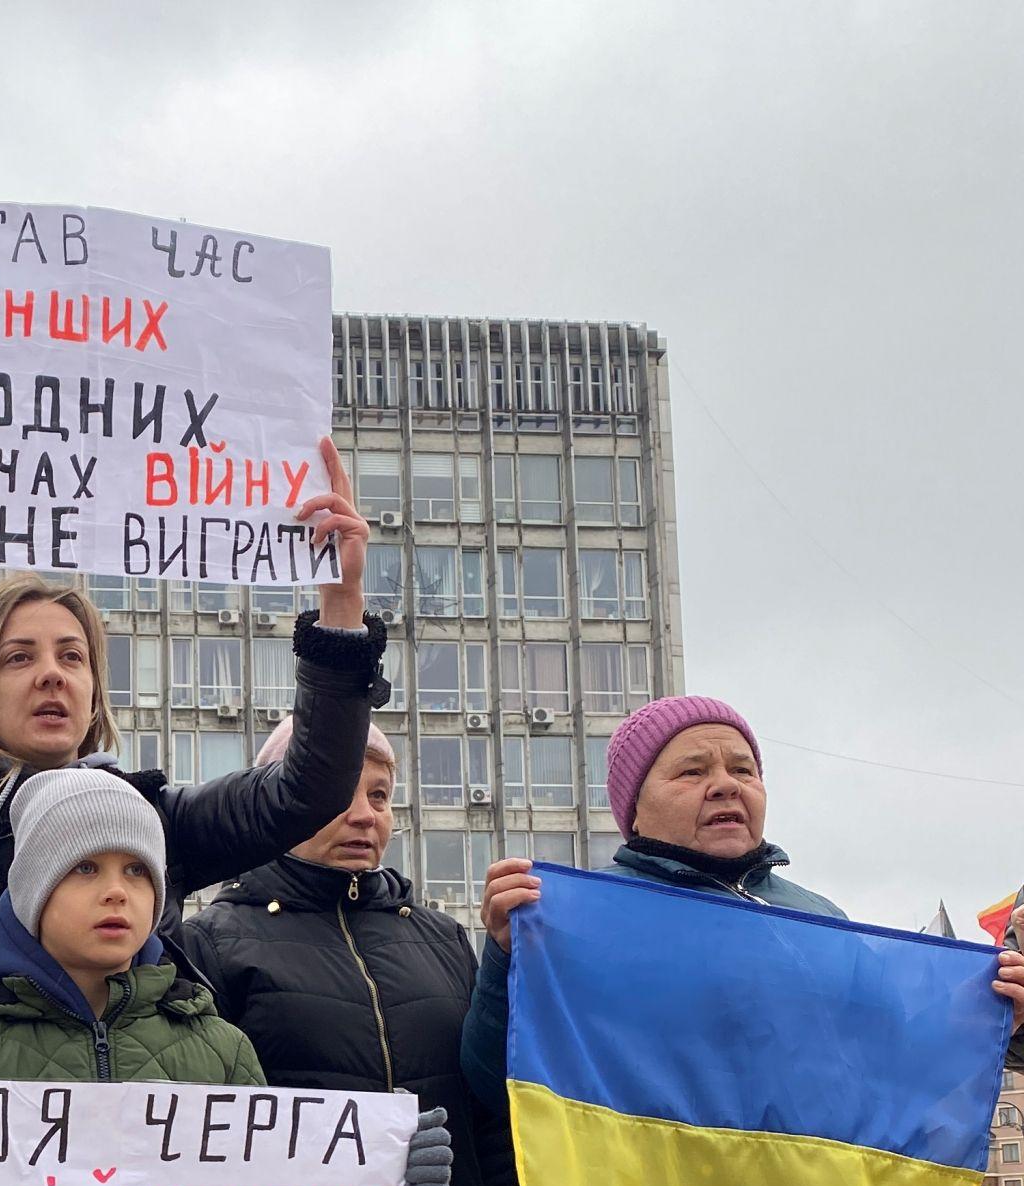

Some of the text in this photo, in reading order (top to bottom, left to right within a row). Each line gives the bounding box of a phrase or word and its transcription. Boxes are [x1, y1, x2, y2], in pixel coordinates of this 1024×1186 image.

[151, 226, 255, 283] ЧАС
[146, 441, 310, 508] ВІЙНУ
[123, 512, 340, 582] ВИГРАТИ
[145, 1093, 366, 1166] ЧЕРГА
